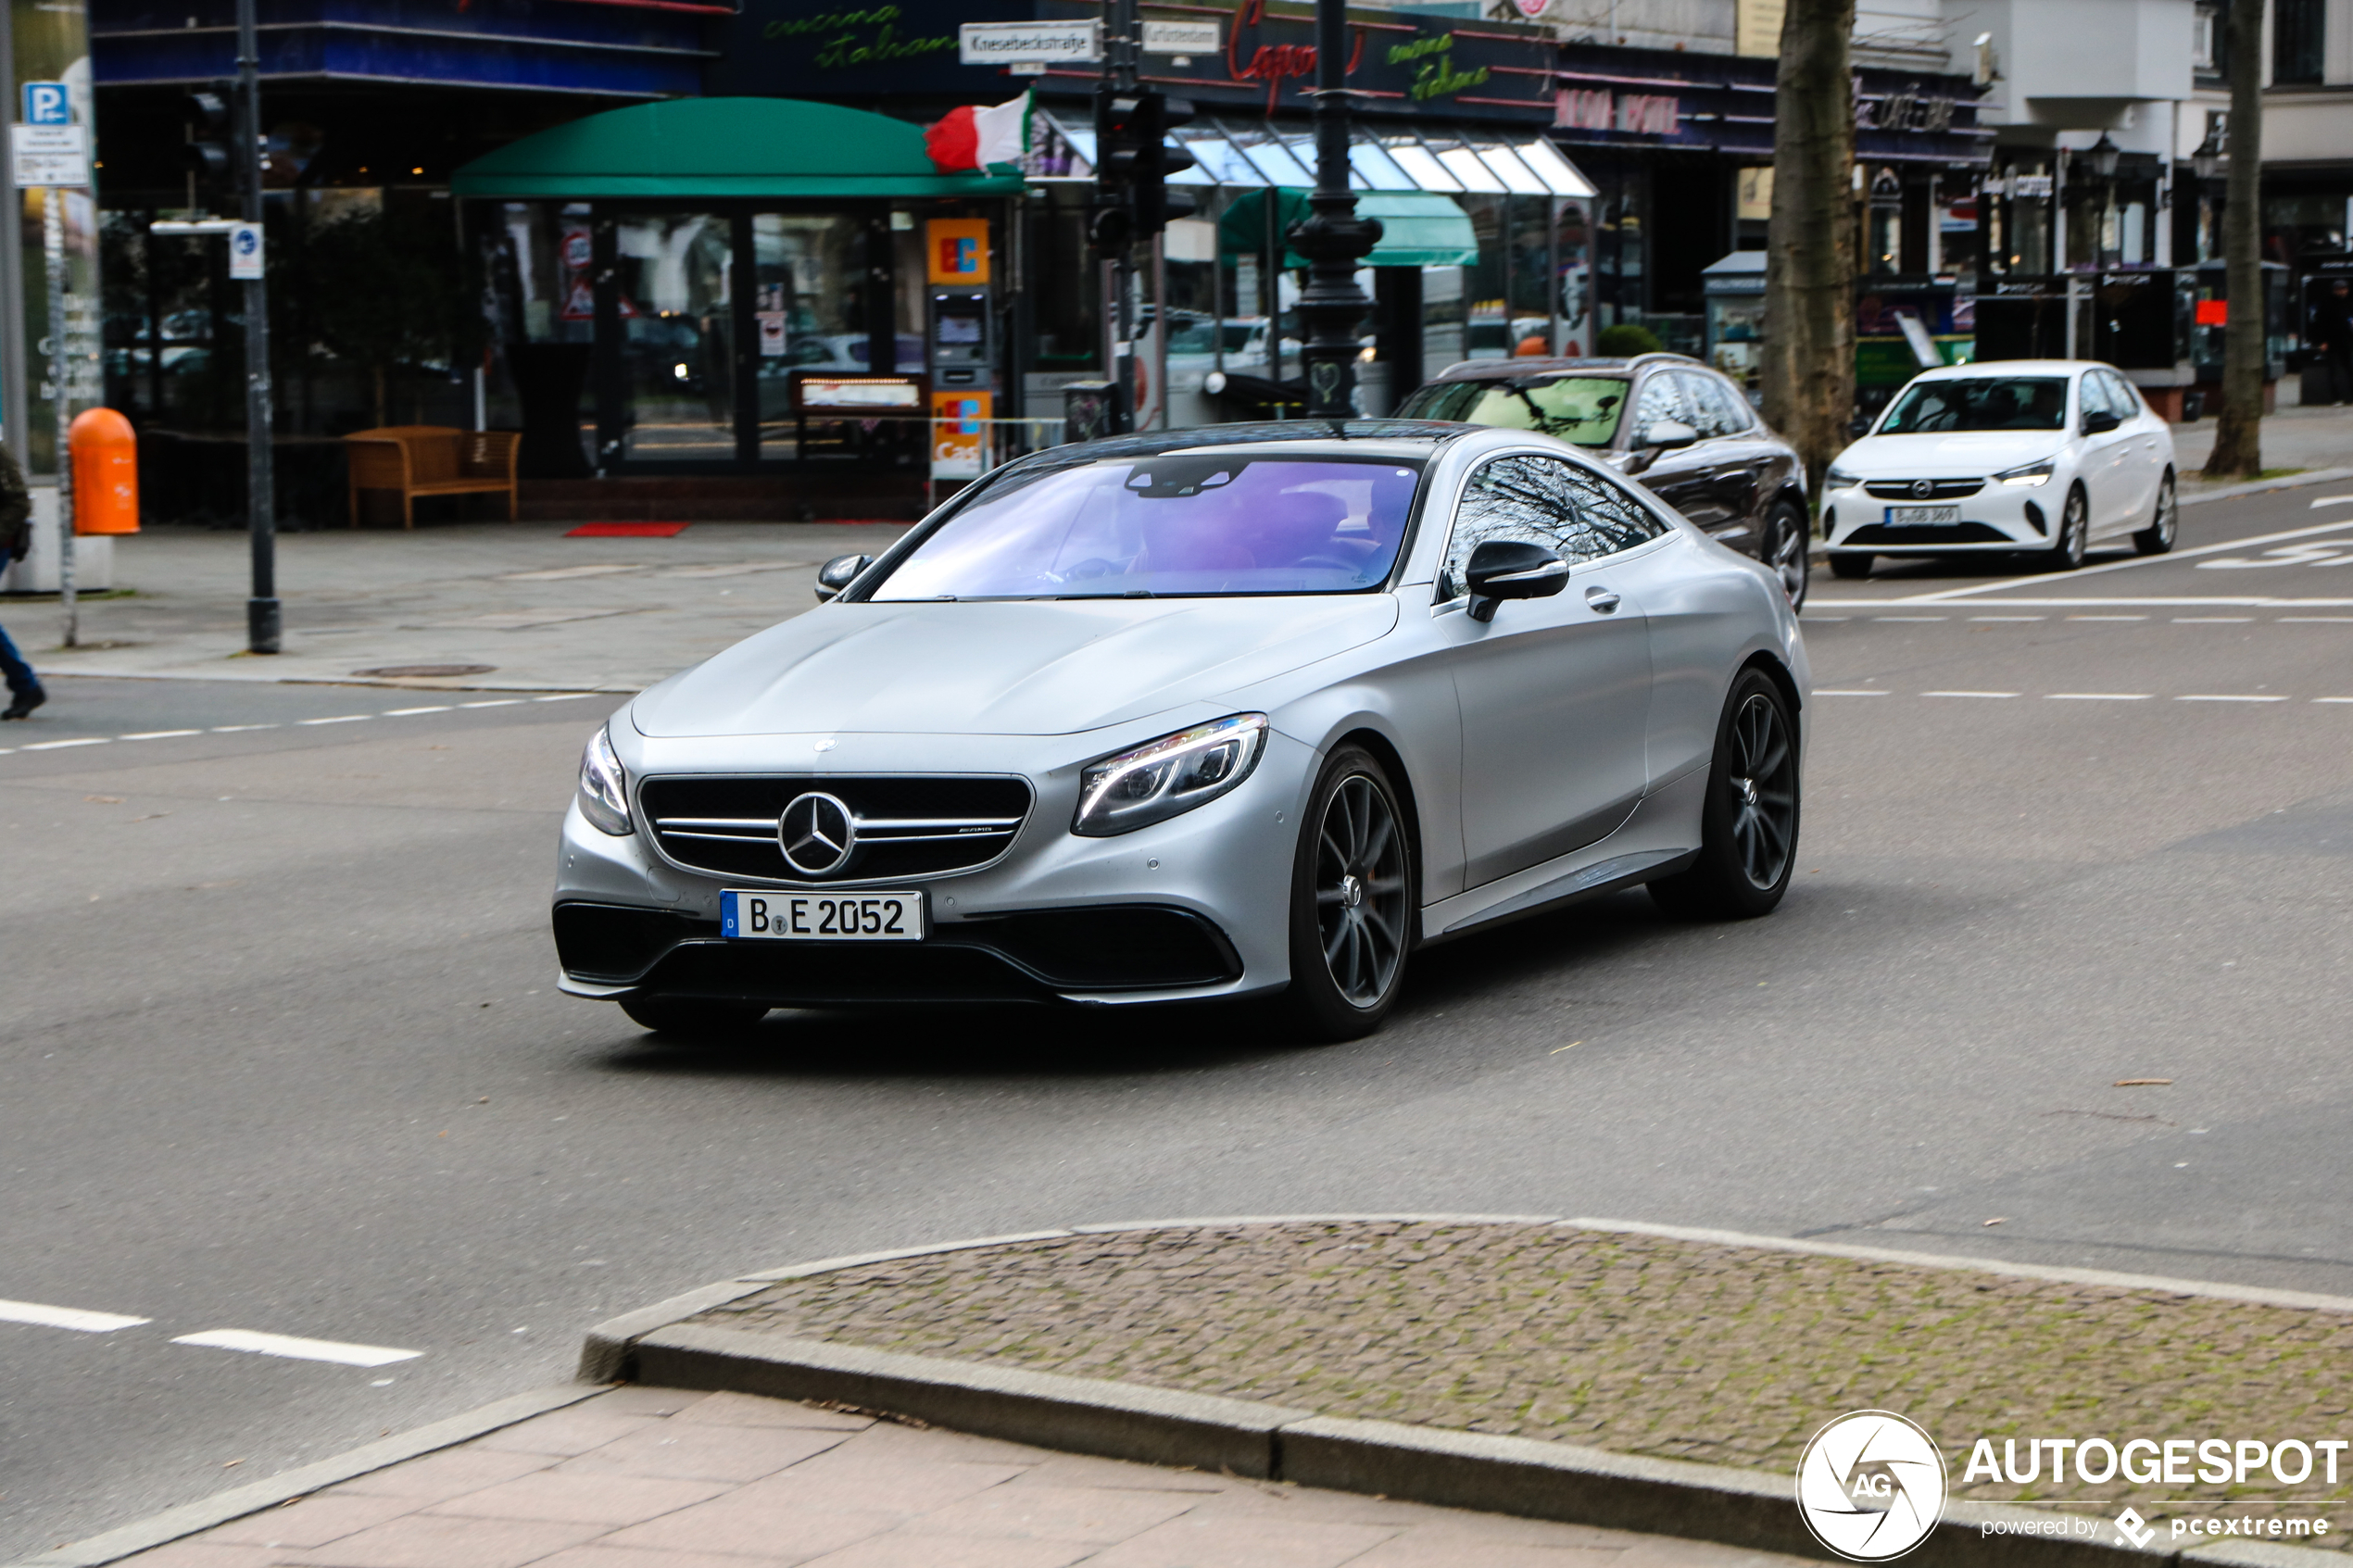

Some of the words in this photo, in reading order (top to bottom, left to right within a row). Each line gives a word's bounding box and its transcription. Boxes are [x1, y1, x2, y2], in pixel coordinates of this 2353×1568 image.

[969, 31, 1088, 54] Knesebeckstraße
[32, 88, 62, 121] P
[727, 919, 734, 929] D
[750, 898, 769, 933] B
[790, 899, 811, 934] E
[818, 899, 904, 935] 2052
